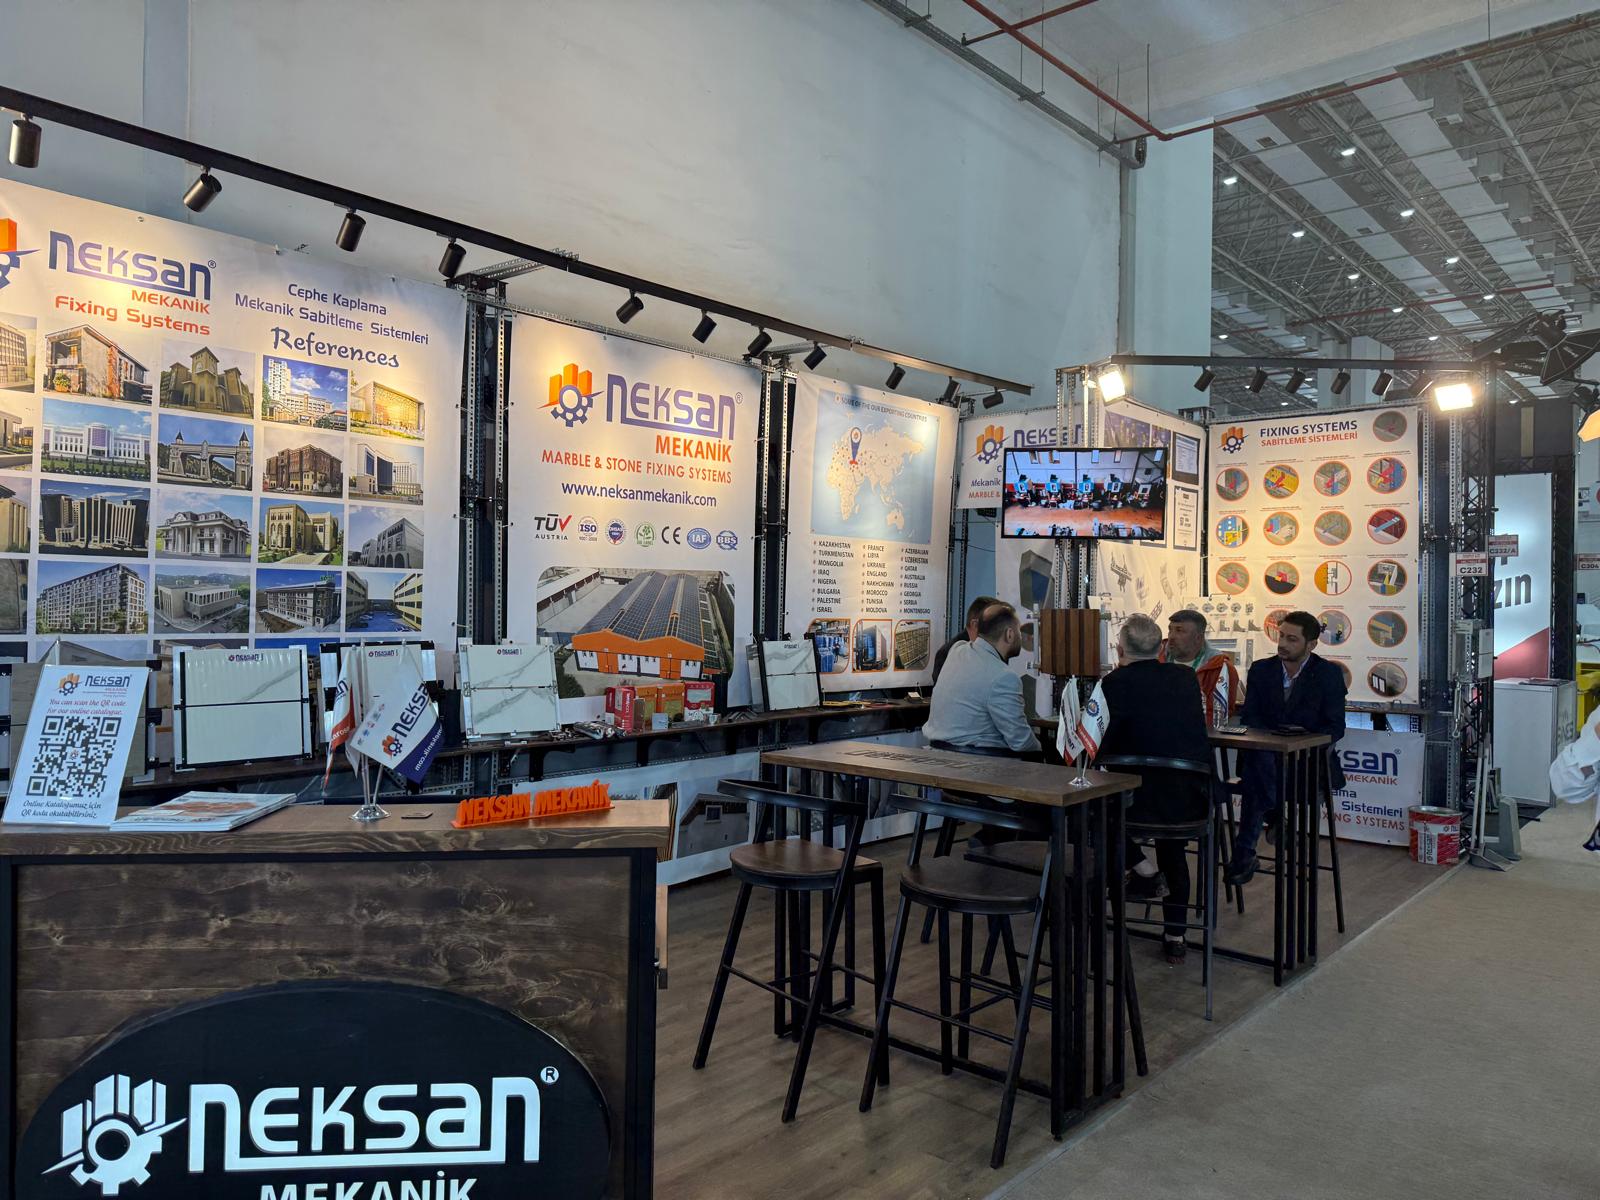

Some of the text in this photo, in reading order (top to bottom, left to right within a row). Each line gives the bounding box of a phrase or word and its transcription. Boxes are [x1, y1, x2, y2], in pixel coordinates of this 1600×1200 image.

[288, 284, 387, 316] Cephe Kaplama
[55, 295, 210, 335] Fixing Systems
[235, 293, 429, 345] Mekanik Sabitleme Sistemleri
[271, 326, 400, 368] References
[1260, 420, 1358, 438] FIXING SYSTEMS
[655, 434, 732, 463] MEKANİK
[542, 450, 732, 484] MARBLE & STONE FIXING SYSTEMS
[562, 482, 717, 507] www.neksanmekanik.com
[535, 533, 568, 541] AUSTRIA
[580, 524, 597, 532] ISO
[662, 526, 681, 545] CE
[692, 533, 706, 543] IAF
[1342, 801, 1402, 818] Sistemleri
[1356, 816, 1405, 832] SYSTEMS
